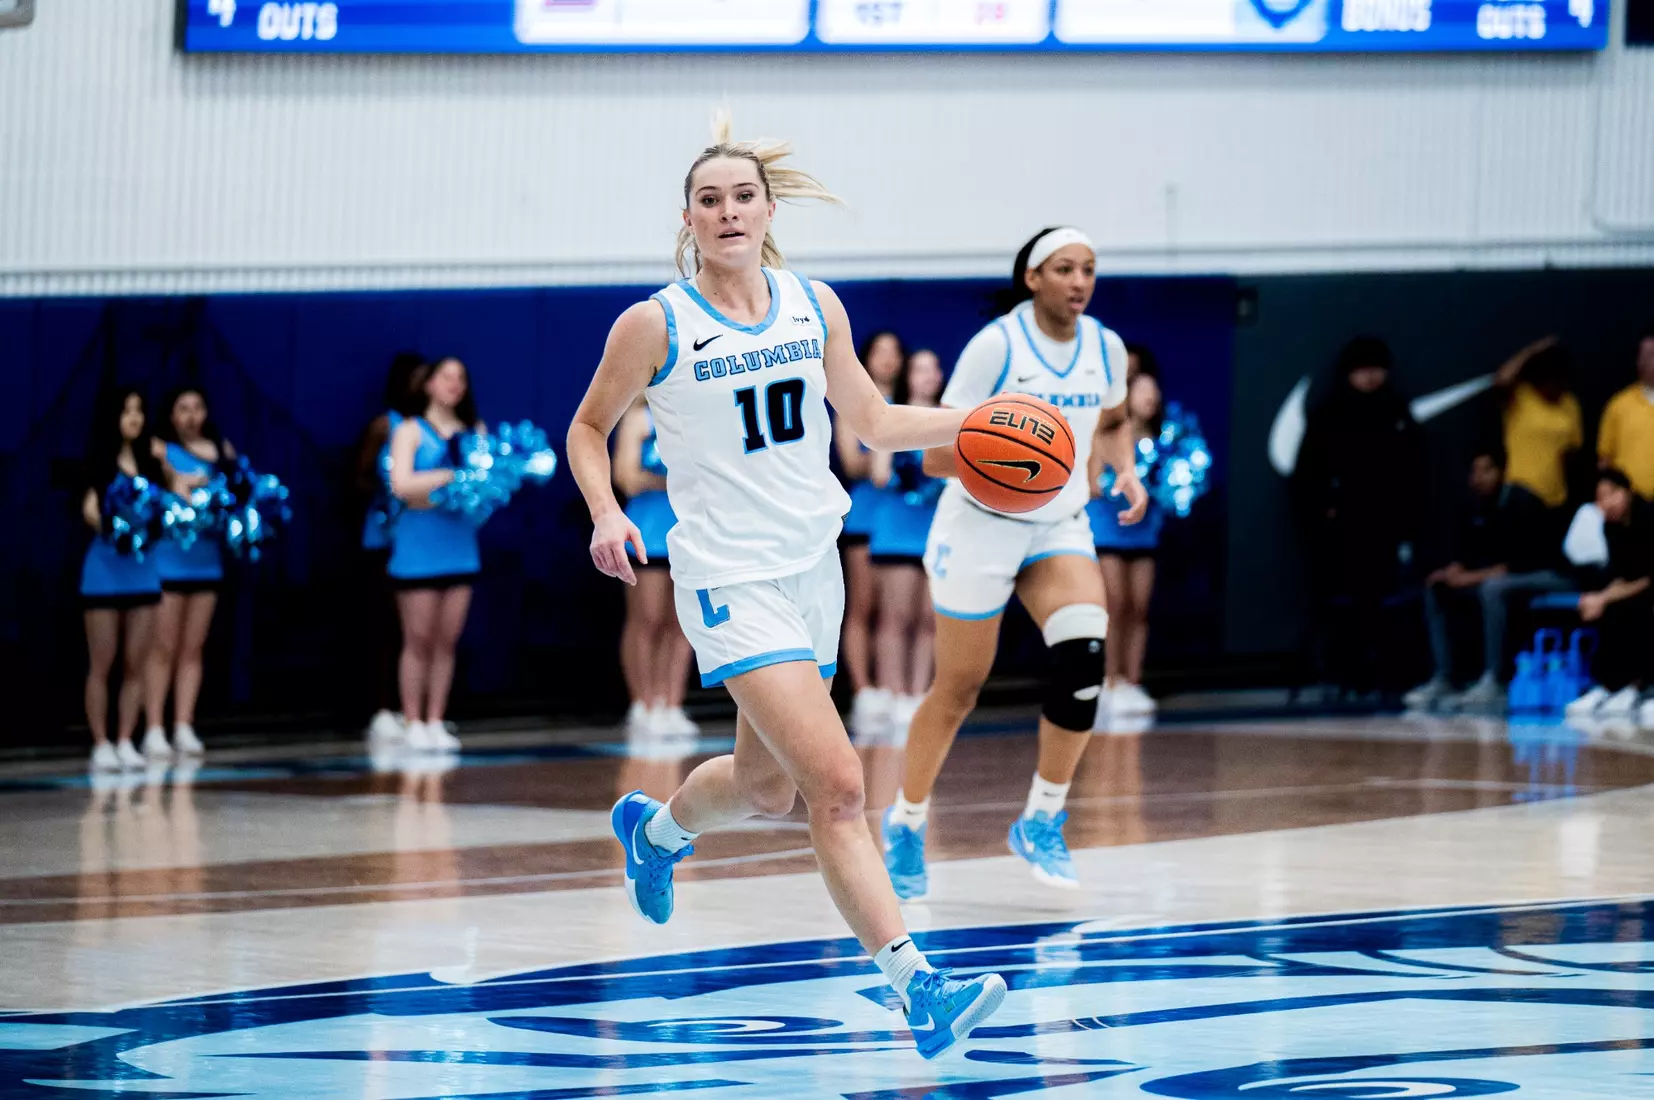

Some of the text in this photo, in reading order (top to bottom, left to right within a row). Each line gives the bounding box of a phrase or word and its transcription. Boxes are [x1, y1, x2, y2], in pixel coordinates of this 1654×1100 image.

[257, 2, 339, 40] OUTS
[693, 339, 822, 382] COLUMBIA
[733, 377, 806, 454] 10
[989, 410, 1056, 446] ELITE
